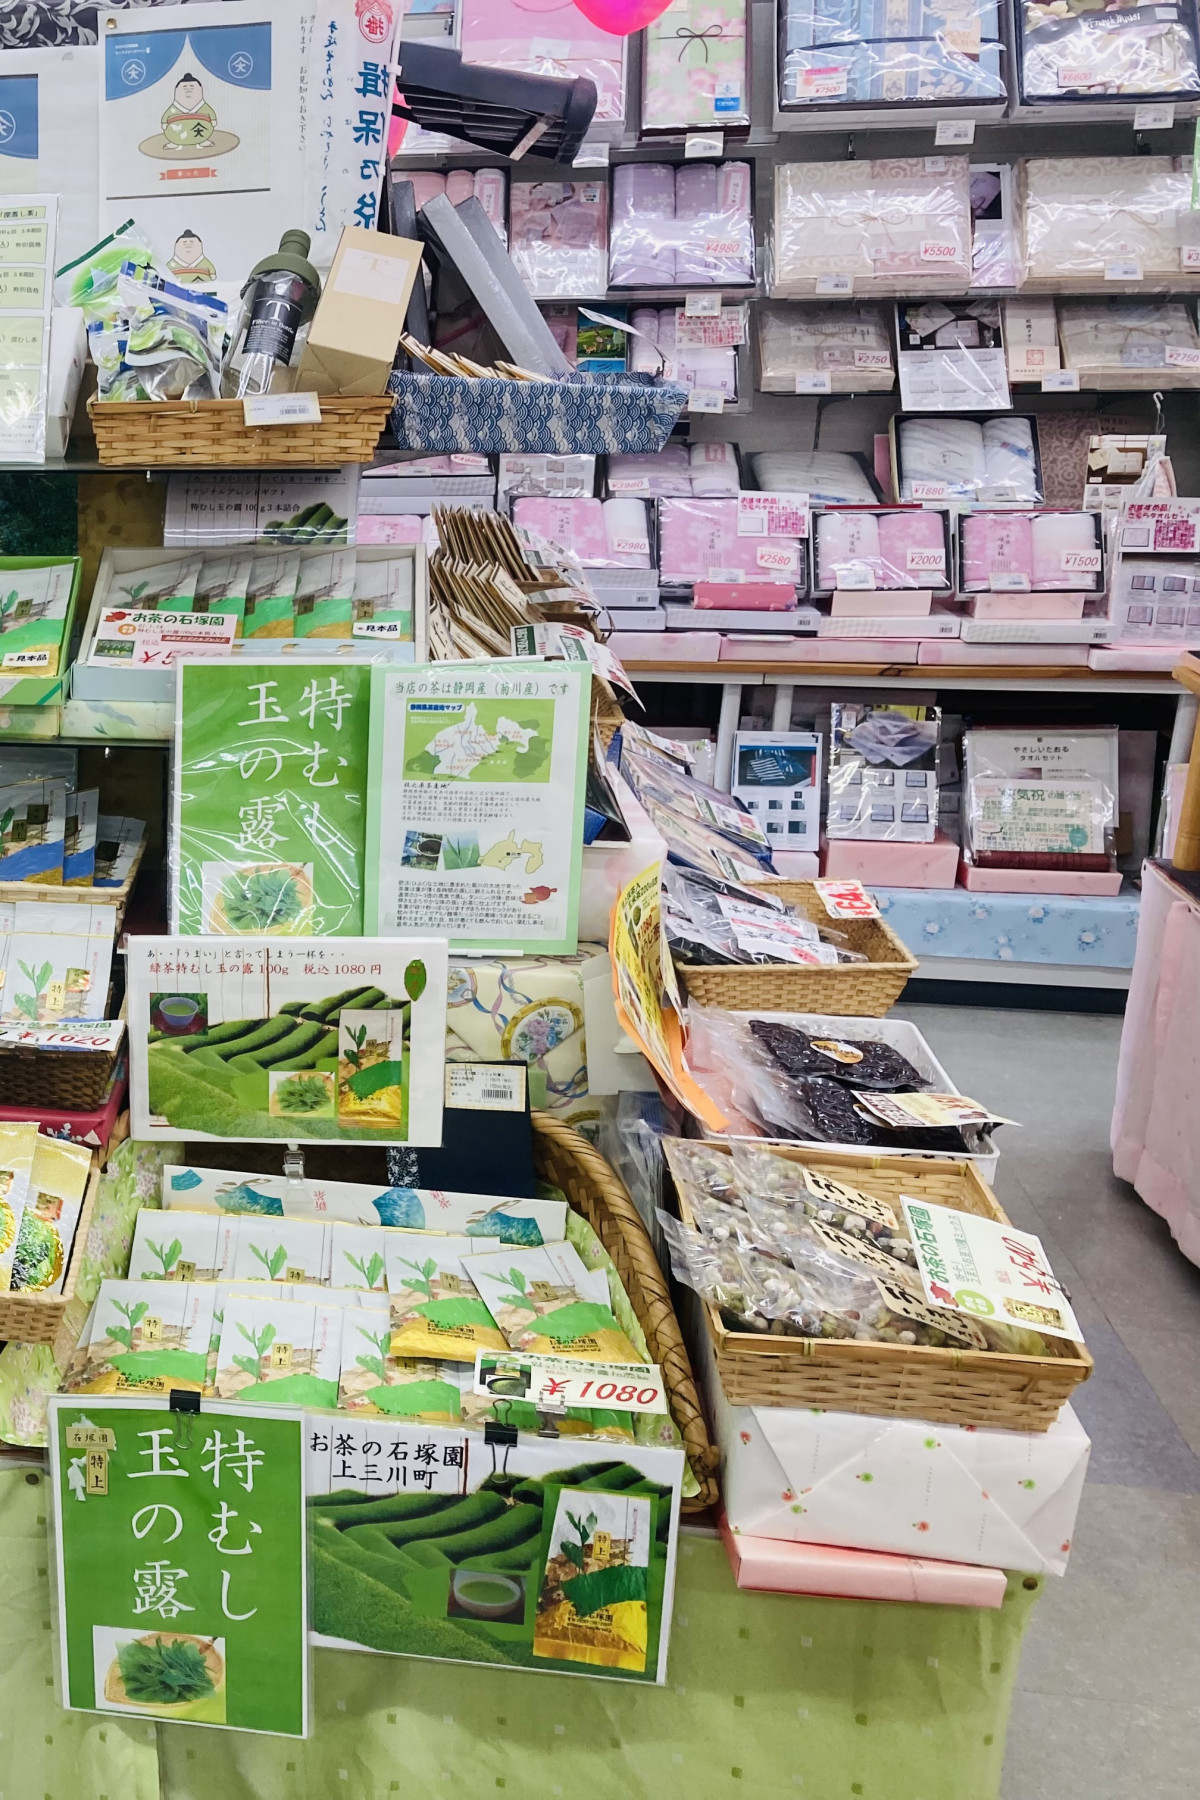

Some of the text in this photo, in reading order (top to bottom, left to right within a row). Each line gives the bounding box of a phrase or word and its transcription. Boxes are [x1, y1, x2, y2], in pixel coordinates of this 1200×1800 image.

[923, 246, 956, 257] ¥5500
[266, 300, 291, 321] T
[760, 552, 791, 566] ¥2580
[910, 553, 943, 566] ¥2000
[1064, 555, 1099, 567] ¥1500
[132, 612, 225, 626] お茶の石塚園
[15, 653, 48, 663] 見本品
[237, 680, 290, 851] 玉の露
[298, 676, 353, 848] 特むし
[20, 1031, 110, 1046] ¥1620
[542, 1377, 659, 1405] ¥1080
[308, 1432, 465, 1469] お茶の石塚園
[89, 1454, 105, 1489] 特上
[331, 1459, 439, 1491] 上三川町
[126, 1428, 196, 1619] 玉の露
[200, 1429, 266, 1620] 特むし
